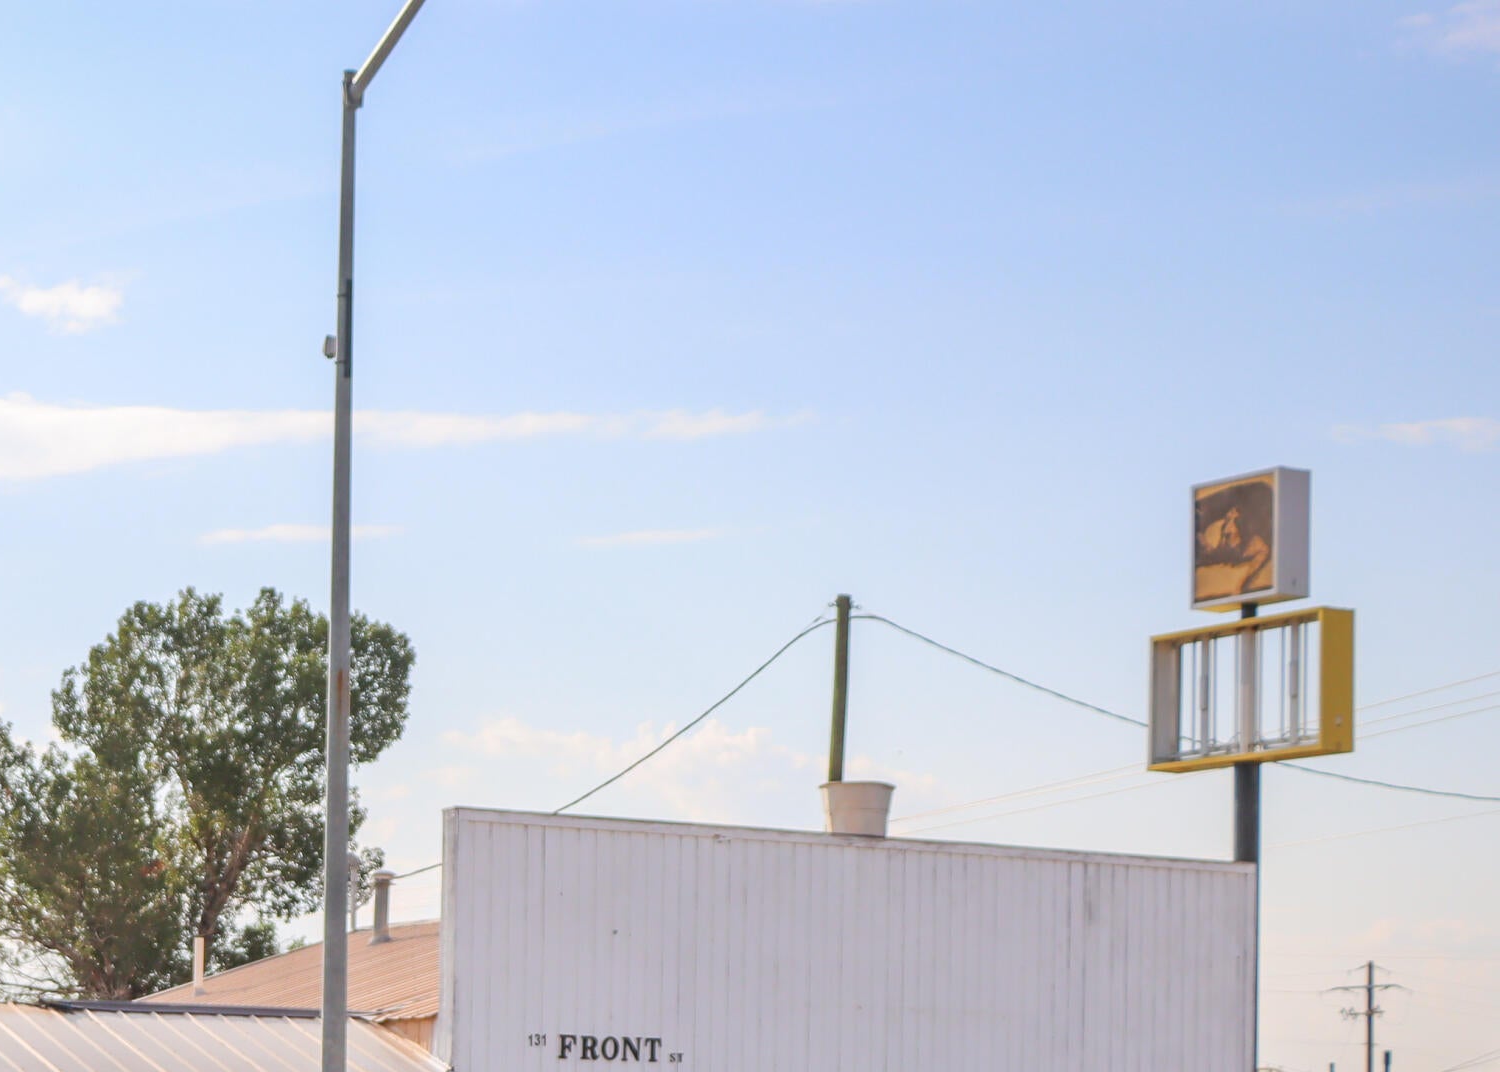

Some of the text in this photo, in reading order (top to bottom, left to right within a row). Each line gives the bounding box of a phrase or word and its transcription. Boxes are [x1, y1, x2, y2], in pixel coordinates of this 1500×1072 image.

[528, 1033, 684, 1063] 131 FRONT ST
